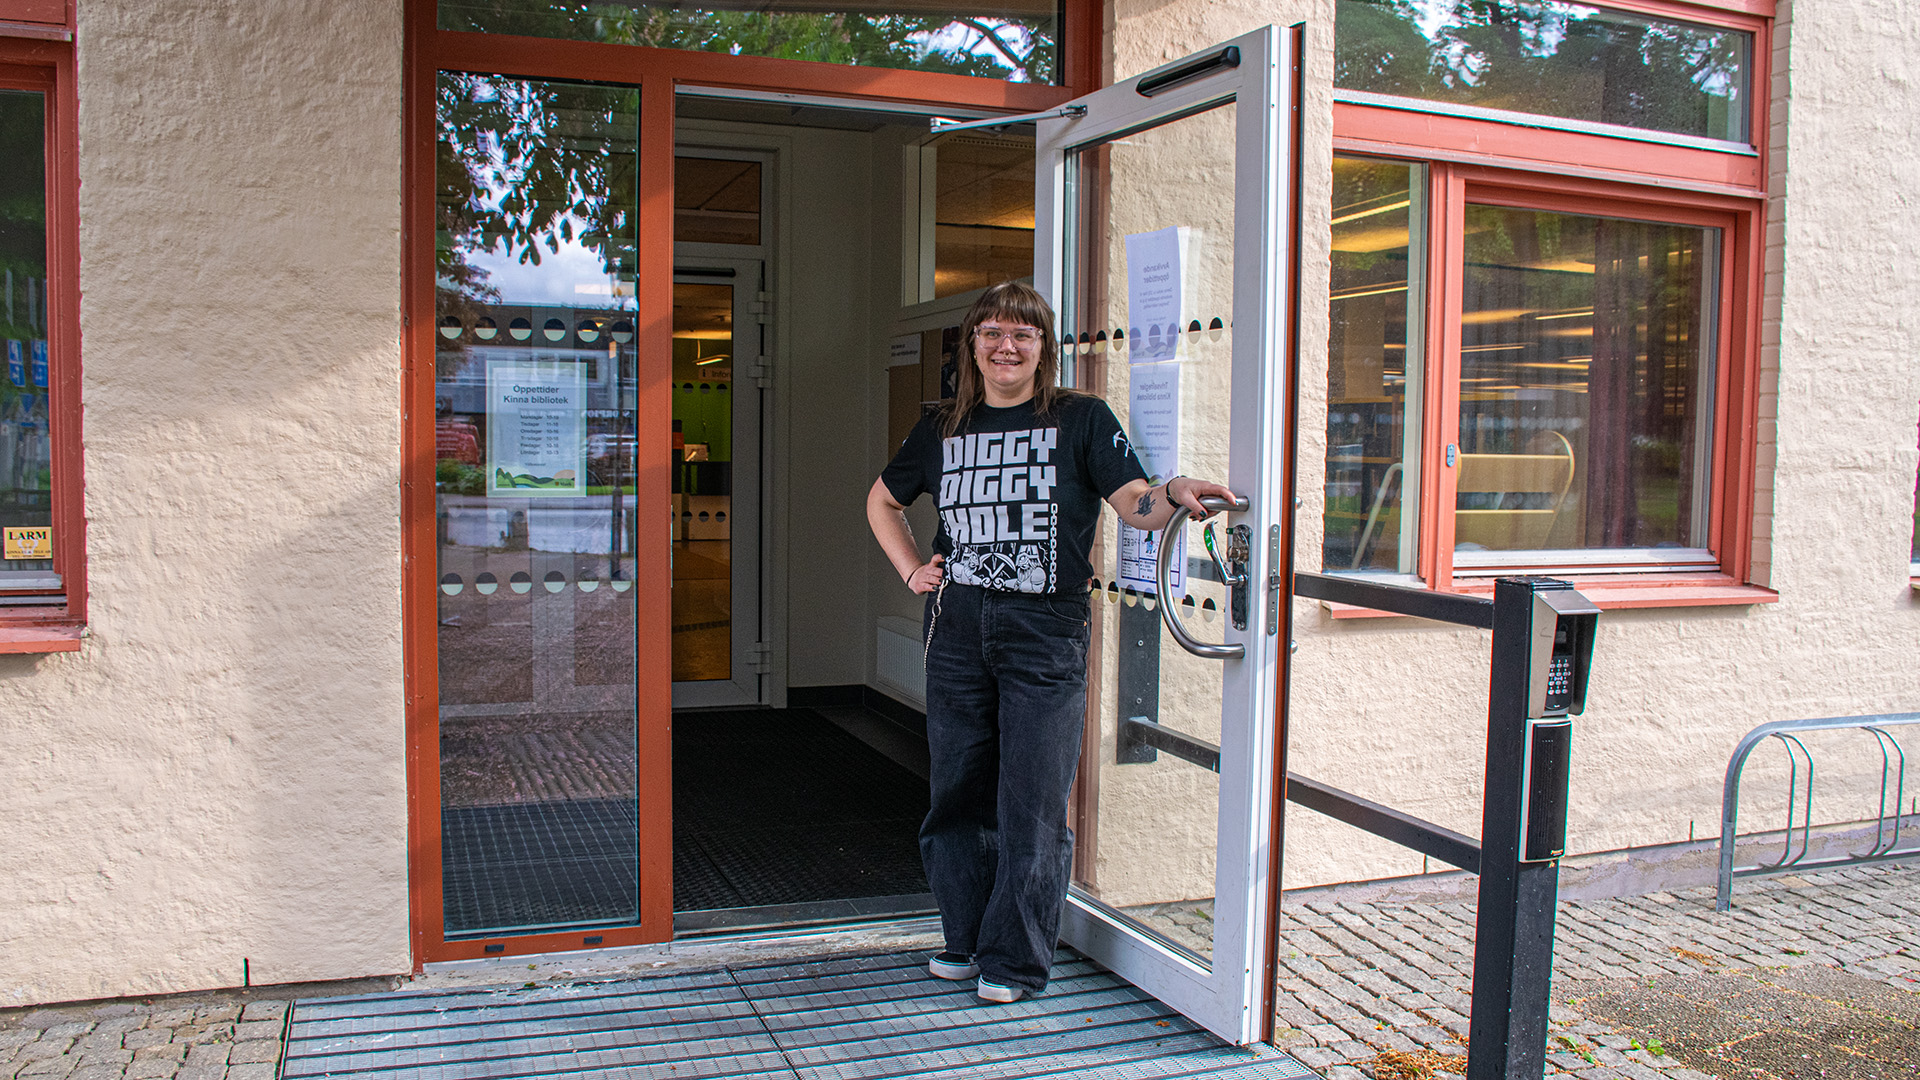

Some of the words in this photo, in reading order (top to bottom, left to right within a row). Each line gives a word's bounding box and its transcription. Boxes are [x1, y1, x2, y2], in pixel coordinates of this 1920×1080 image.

[503, 395, 530, 403] Kinna
[531, 396, 569, 404] bibliotek
[513, 384, 560, 394] Öppettider
[942, 427, 1058, 473] DIGGY
[939, 465, 1057, 509] DIGGY
[9, 531, 46, 540] LARM
[944, 503, 1049, 544] HOLE
